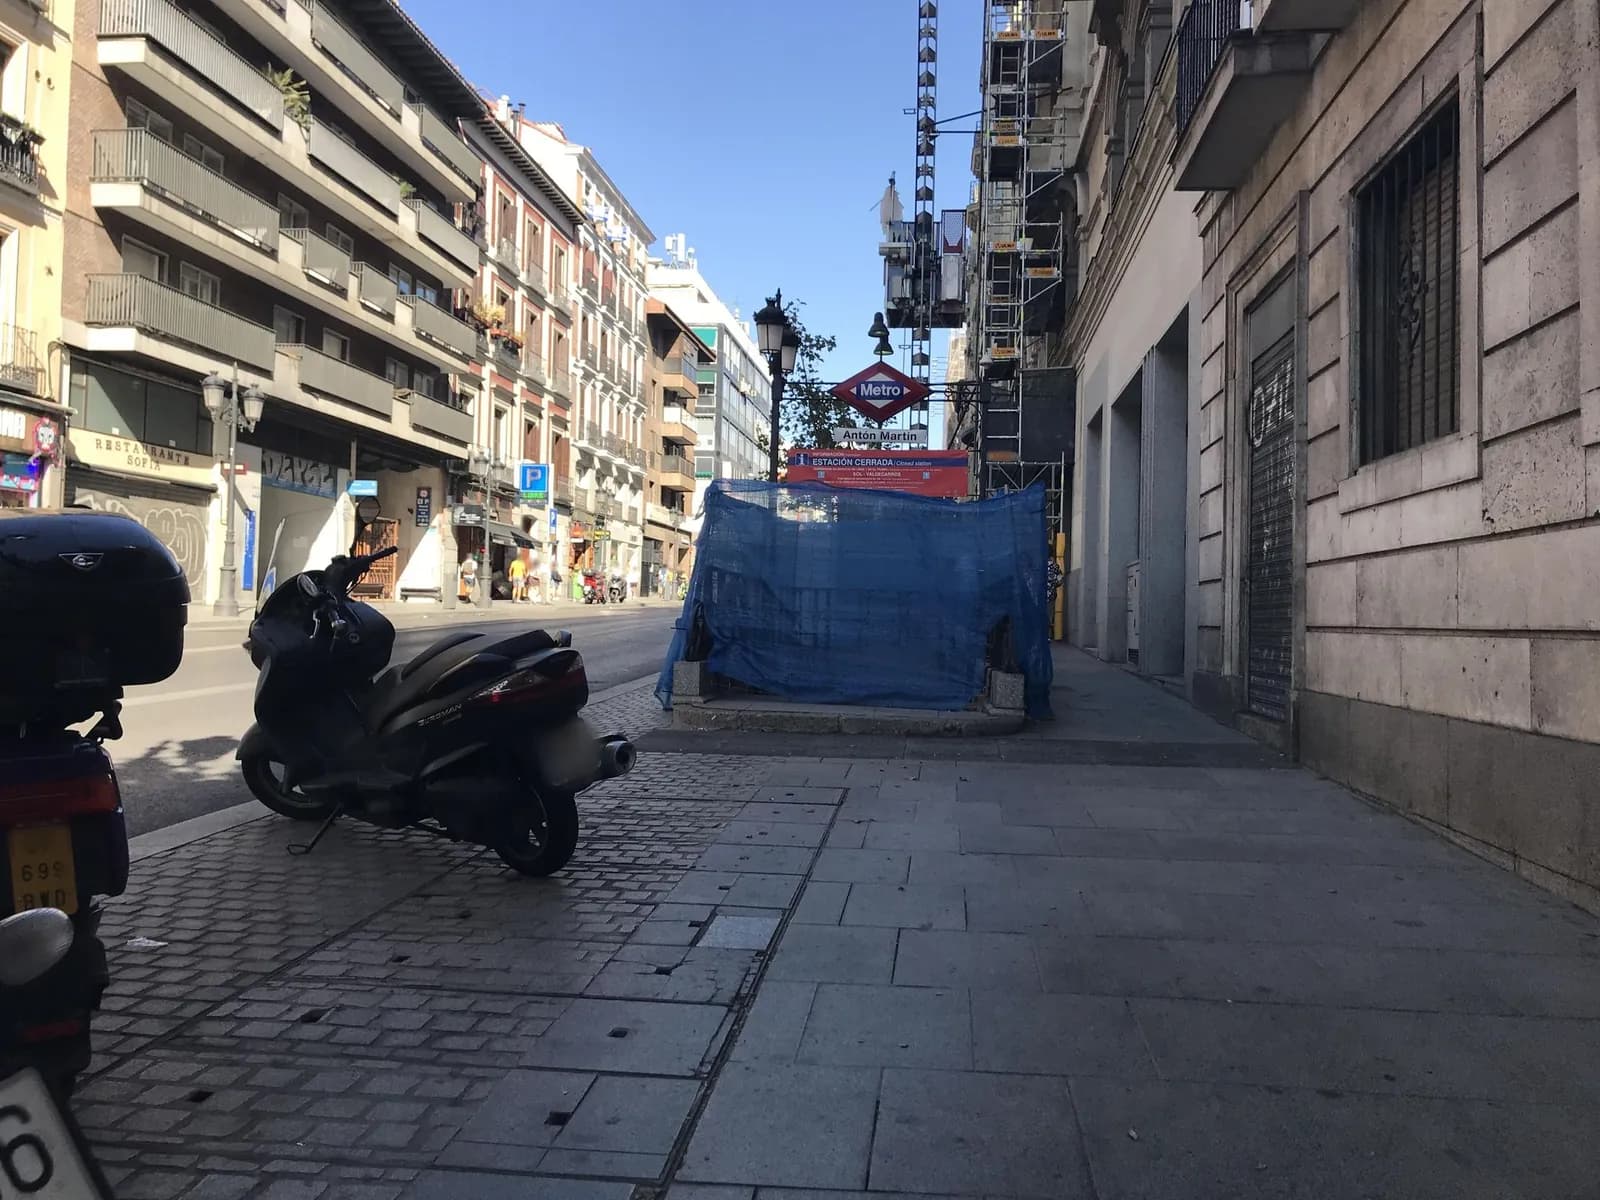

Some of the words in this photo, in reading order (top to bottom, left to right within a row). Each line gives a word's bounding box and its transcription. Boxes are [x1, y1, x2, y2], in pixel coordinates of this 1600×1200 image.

[860, 383, 901, 396] Metro
[843, 430, 876, 440] Antón
[880, 431, 917, 441] Martín
[95, 438, 190, 466] RESTAURANTE
[812, 457, 853, 466] ESTACIÓN
[854, 458, 894, 466] CERRADA
[526, 468, 541, 489] P
